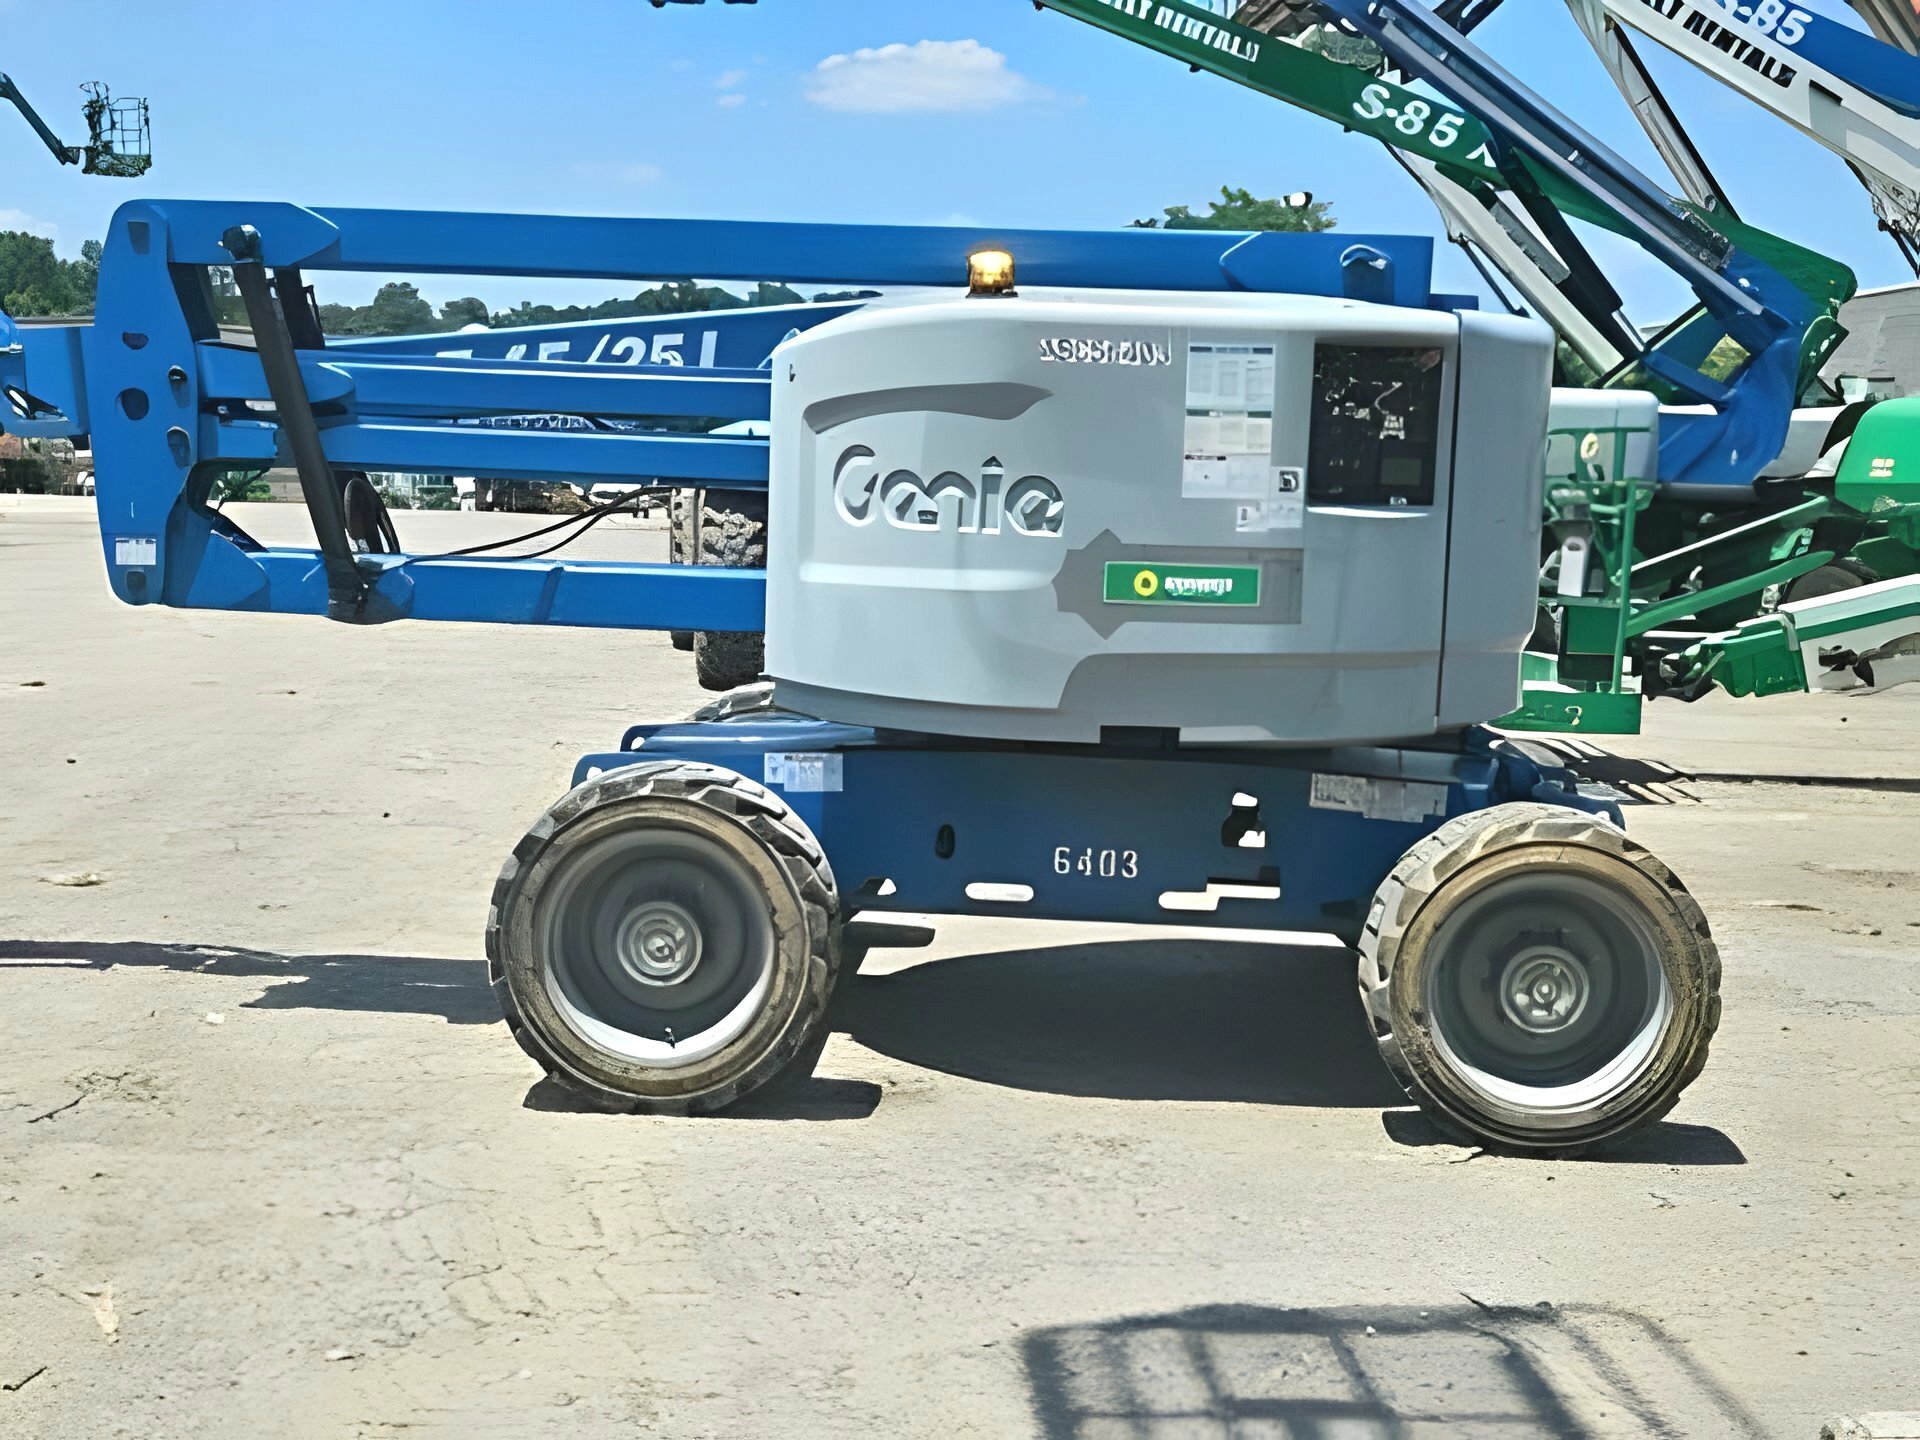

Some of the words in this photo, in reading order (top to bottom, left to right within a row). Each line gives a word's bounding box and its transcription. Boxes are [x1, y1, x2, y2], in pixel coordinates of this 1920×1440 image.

[1352, 83, 1465, 148] S-85
[832, 444, 1064, 538] Genie
[1054, 846, 1138, 878] 6403
